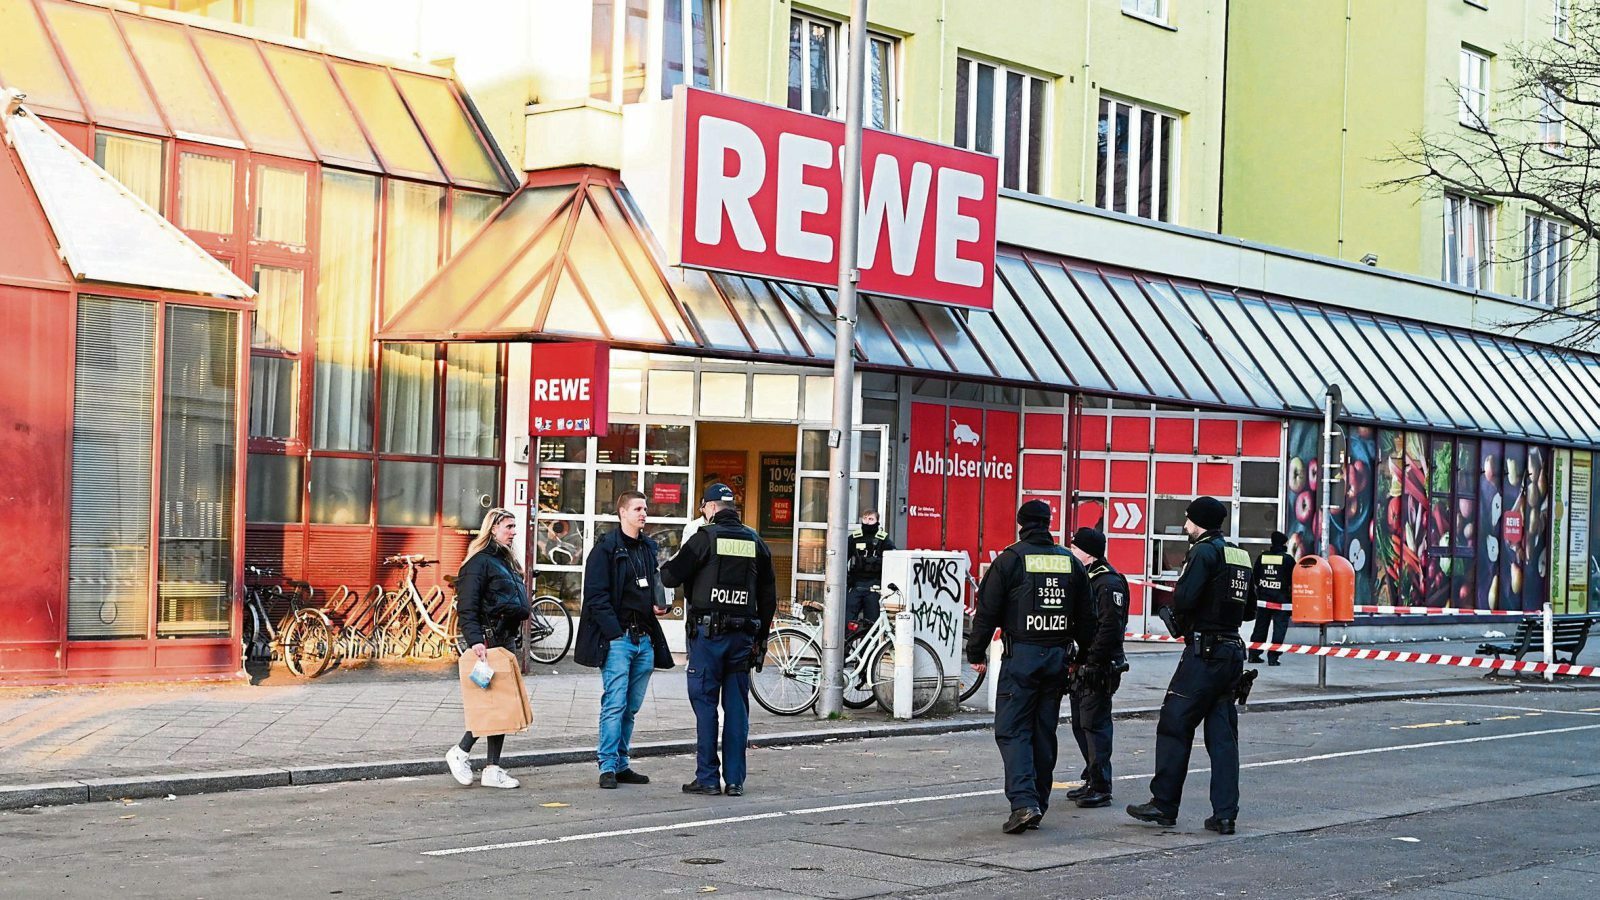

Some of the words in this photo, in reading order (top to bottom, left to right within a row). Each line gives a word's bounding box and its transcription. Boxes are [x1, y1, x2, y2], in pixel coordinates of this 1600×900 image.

[695, 115, 985, 288] REWE
[534, 378, 591, 401] REWE
[913, 450, 1013, 480] Abholservice
[769, 468, 781, 481] 10
[1506, 517, 1520, 527] REWE
[719, 541, 755, 555] POLIZEI
[1028, 557, 1069, 571] POLIZEI
[1046, 577, 1058, 587] BE
[1237, 570, 1245, 580] BE
[1259, 579, 1281, 589] POLIZEI
[710, 588, 749, 605] POLIZEI
[1038, 587, 1066, 598] 35101
[1026, 615, 1068, 631] POLIZEI
